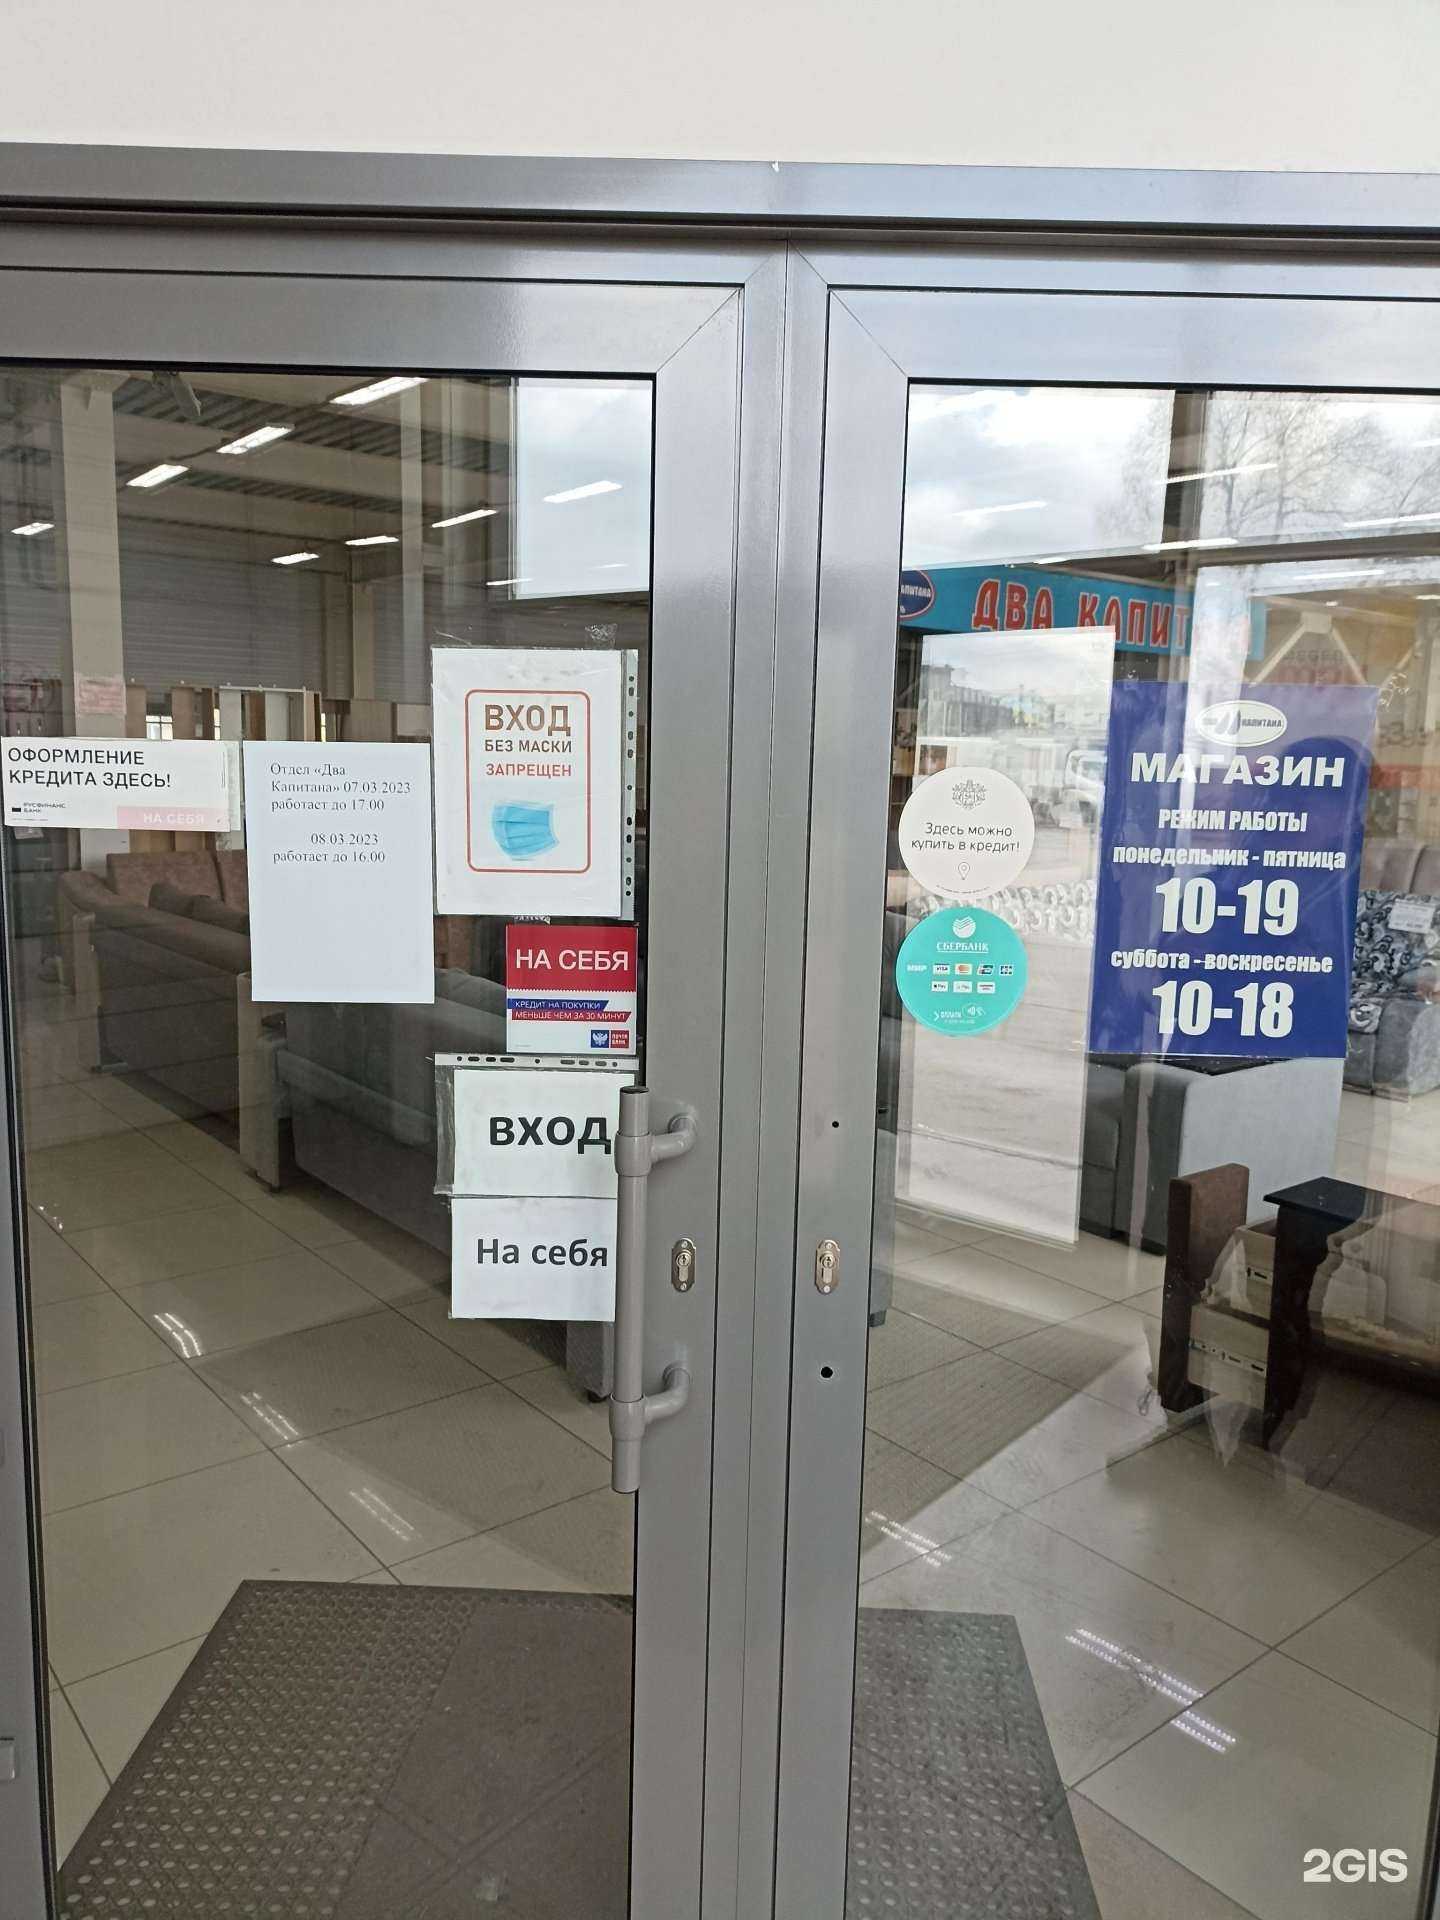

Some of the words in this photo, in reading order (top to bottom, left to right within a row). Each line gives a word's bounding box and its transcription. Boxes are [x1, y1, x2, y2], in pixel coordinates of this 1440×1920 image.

[971, 578, 1053, 631] ДВА
[1077, 592, 1190, 649] КАПИТ
[485, 704, 571, 736] ВХОД
[485, 739, 513, 752] БЕЗ
[518, 740, 572, 752] МАСКИ
[8, 748, 145, 765] ОФОРМЛЕНИЕ
[270, 762, 310, 775] Отдел
[314, 763, 346, 776] «Два
[486, 763, 571, 779] ЗАПРЕЩЕН
[1131, 752, 1345, 788] МАГАЗИН
[9, 770, 97, 788] КРЕДИТА
[103, 772, 171, 790] ЗДЕСЬ!
[271, 780, 339, 793] Капитана»
[271, 798, 328, 812] работает
[331, 801, 347, 810] до
[143, 813, 162, 824] НА
[1158, 809, 1225, 830] РЕЖИМ
[1228, 811, 1309, 832] РАБОТЫ
[925, 822, 964, 836] Здесь
[968, 826, 1012, 837] можно
[311, 833, 379, 845] 08.03.2023
[911, 839, 954, 851] купить
[959, 841, 965, 850] в
[970, 841, 1019, 854] кредит!
[273, 850, 328, 864] работает
[332, 853, 348, 863] до
[1113, 846, 1249, 867] понедельник
[1263, 850, 1347, 871] пятница
[1155, 877, 1299, 936] 10-19
[936, 942, 989, 951] СБЕРБАНК
[516, 948, 552, 969] НА
[559, 949, 629, 971] СЕБЯ
[1110, 949, 1190, 970] суббота
[1204, 953, 1333, 973] воскресенье
[515, 1000, 546, 1009] КРЕДИТ
[562, 1001, 600, 1010] ПОКУПКИ
[1152, 980, 1294, 1038] 10-18
[515, 1011, 552, 1019] МЕНЬШЕ
[586, 1012, 596, 1020] 30
[598, 1012, 626, 1020] МИНУТ
[489, 1116, 612, 1155] ВХОД
[477, 1238, 520, 1265] На
[531, 1238, 608, 1267] себя
